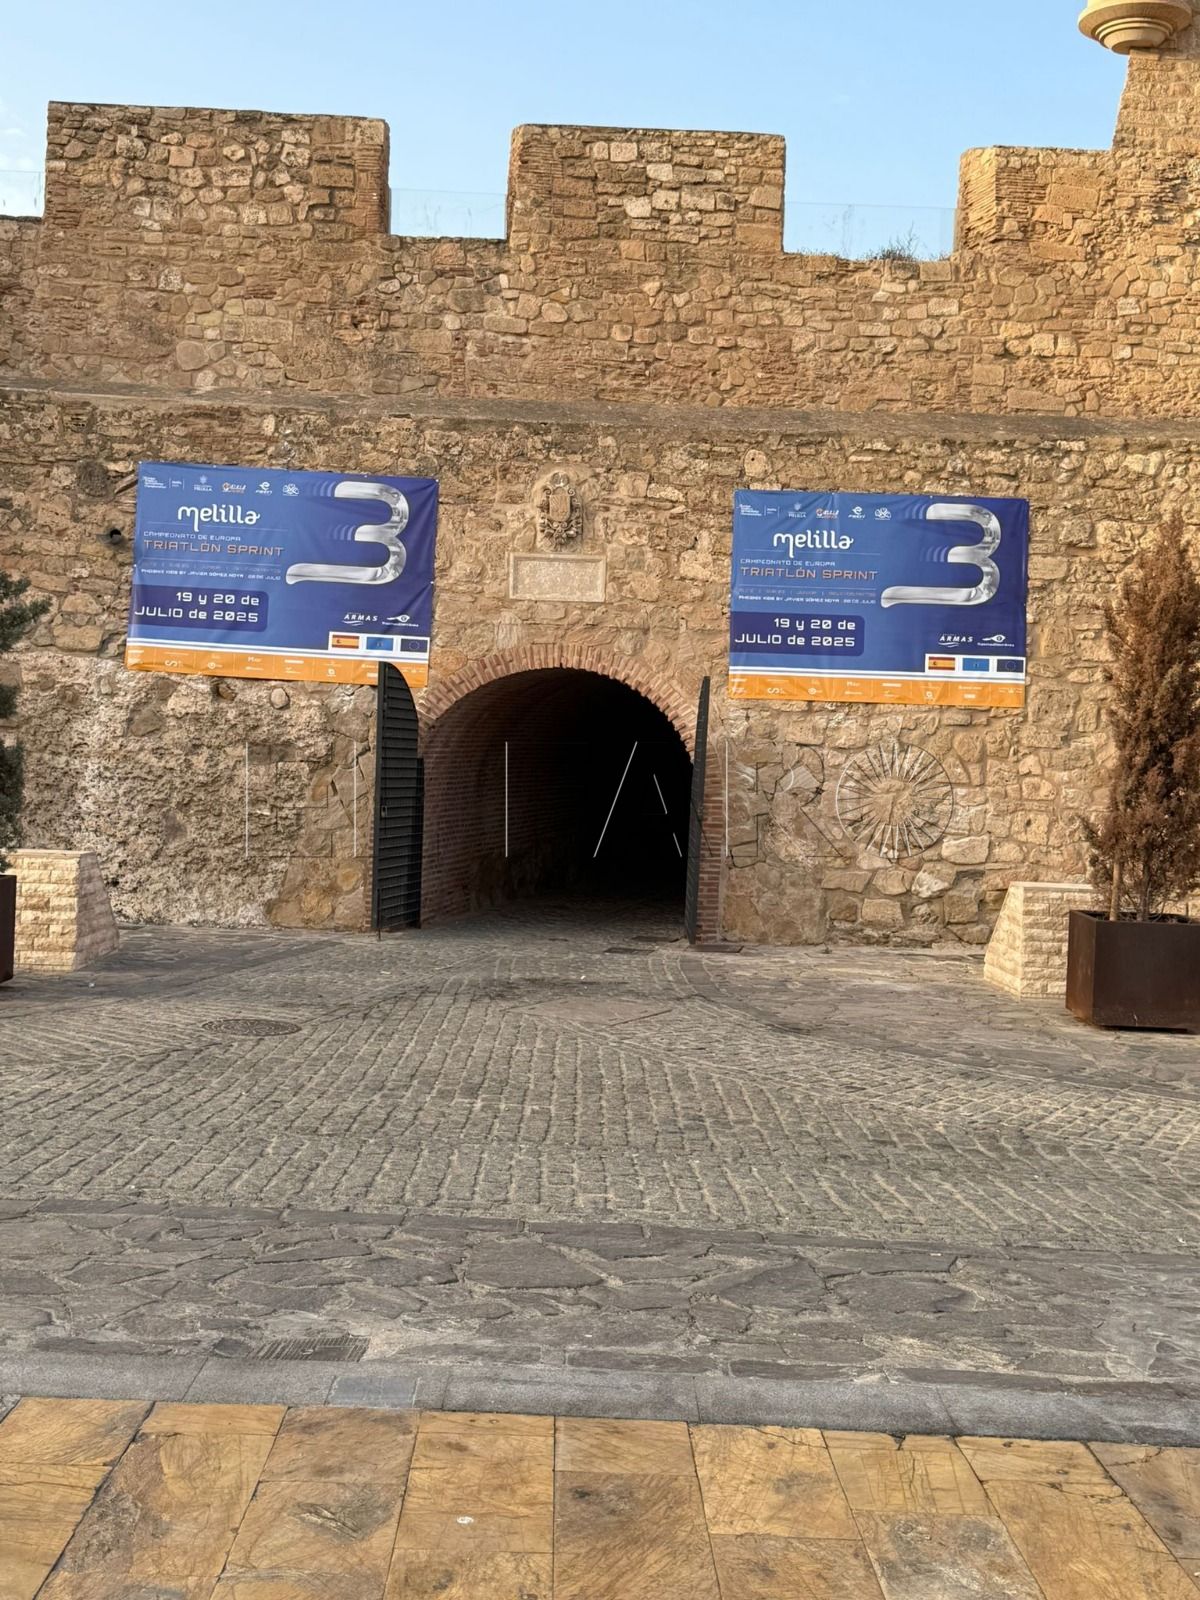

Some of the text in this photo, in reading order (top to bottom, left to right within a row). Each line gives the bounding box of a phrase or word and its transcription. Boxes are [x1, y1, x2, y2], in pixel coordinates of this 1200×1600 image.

[177, 503, 261, 532] melilla
[143, 531, 195, 539] CAMPEONATO
[143, 540, 284, 556] TRIATLÓN SPRINT
[773, 529, 855, 558] melilla
[740, 558, 791, 566] CAMPEONATO
[740, 567, 878, 580] TRIATLÓN SPRINT
[176, 592, 259, 606] 19 y 20 de
[134, 606, 258, 622] JULIO de 2025
[343, 614, 378, 622] ARMAS
[774, 618, 856, 631] 19 y 20 de
[735, 633, 855, 647] JULIO de 2025
[940, 635, 973, 643] ARMAS
